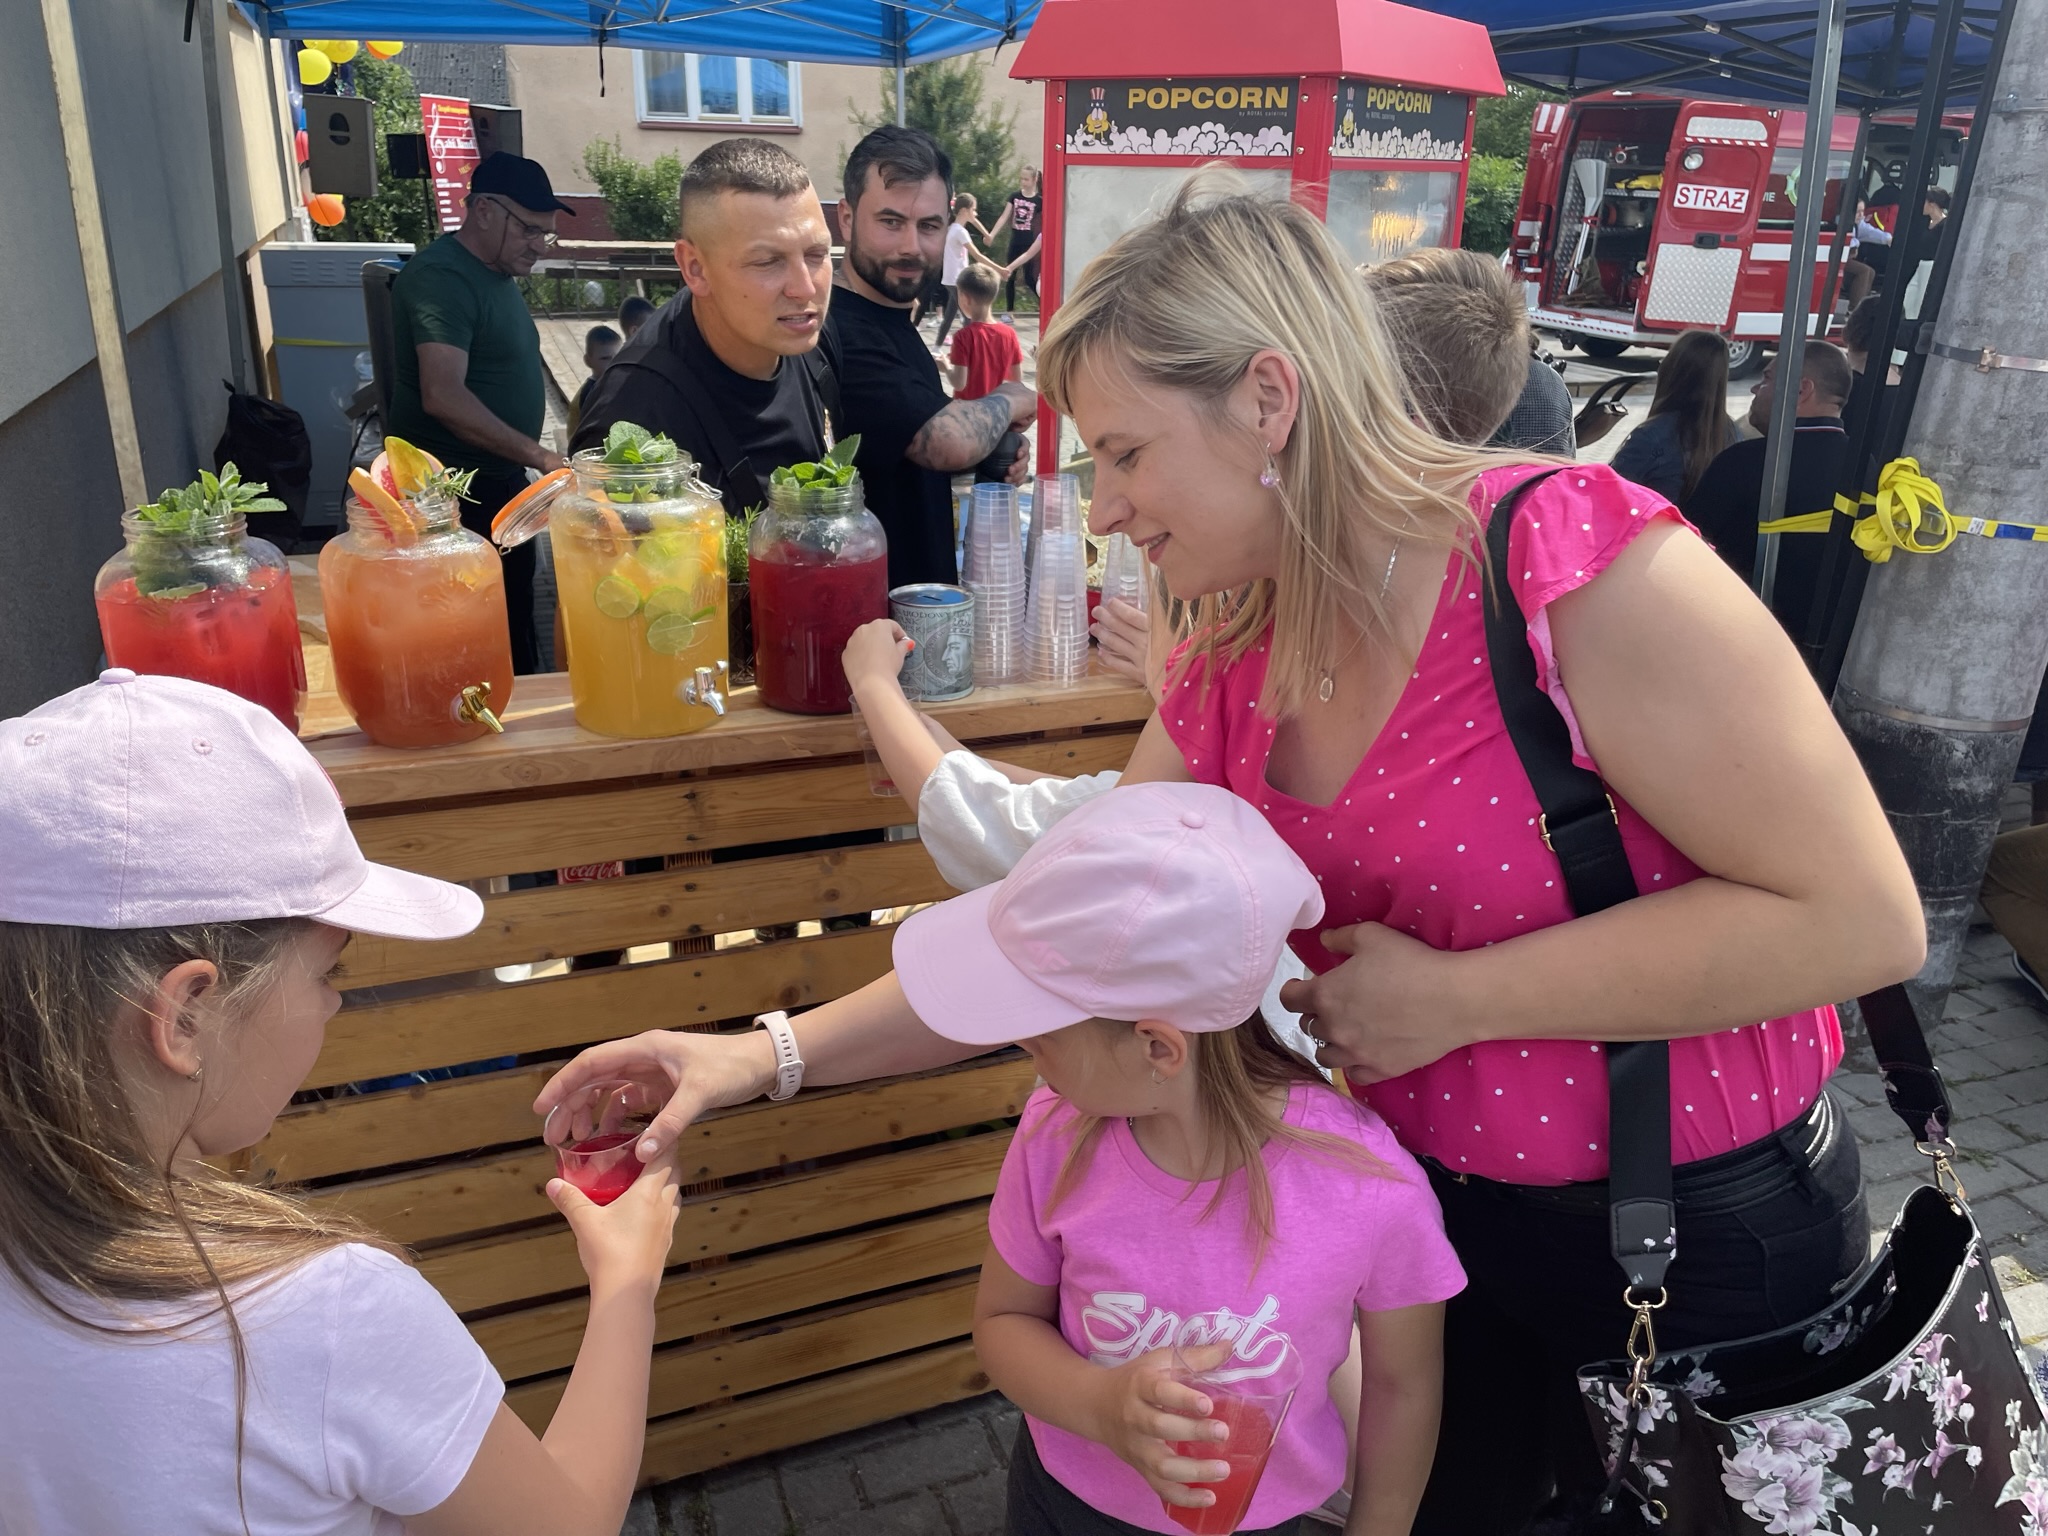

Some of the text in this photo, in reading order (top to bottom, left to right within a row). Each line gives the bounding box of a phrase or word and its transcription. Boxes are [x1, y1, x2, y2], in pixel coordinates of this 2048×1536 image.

[1128, 86, 1289, 110] POPCORN
[1366, 87, 1433, 114] POPCORN
[1082, 1291, 1289, 1383] Sport
